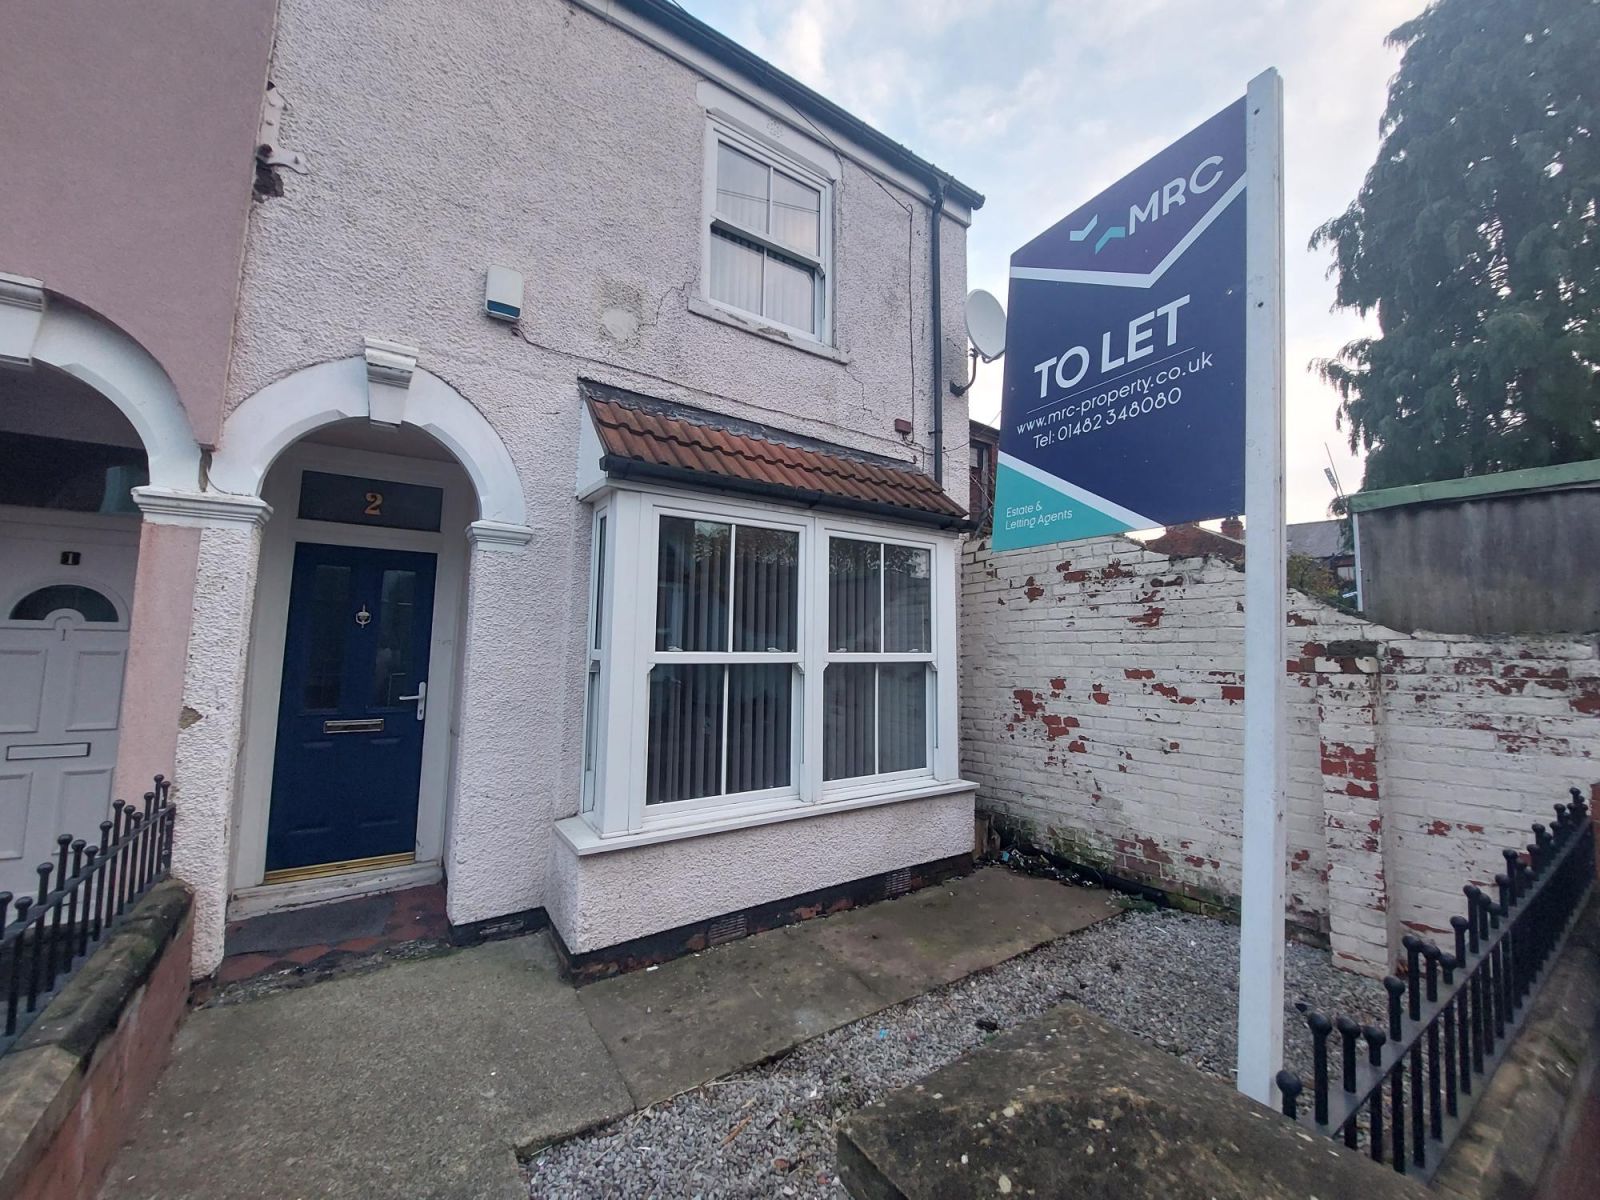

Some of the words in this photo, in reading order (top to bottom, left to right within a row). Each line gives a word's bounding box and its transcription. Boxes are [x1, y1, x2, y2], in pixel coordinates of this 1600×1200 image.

[1129, 155, 1224, 236] MRC
[1034, 345, 1090, 399] TO
[1101, 294, 1191, 374] LET
[1016, 351, 1214, 435] www.mrc-property.co.uk
[1033, 430, 1055, 449] Tel:
[1057, 414, 1102, 441] 01482
[1105, 387, 1182, 425] 348080
[364, 492, 384, 516] 2
[1005, 516, 1036, 530] Letting
[1037, 510, 1073, 526] Agents
[1006, 504, 1034, 518] Estate
[1035, 500, 1042, 512] &
